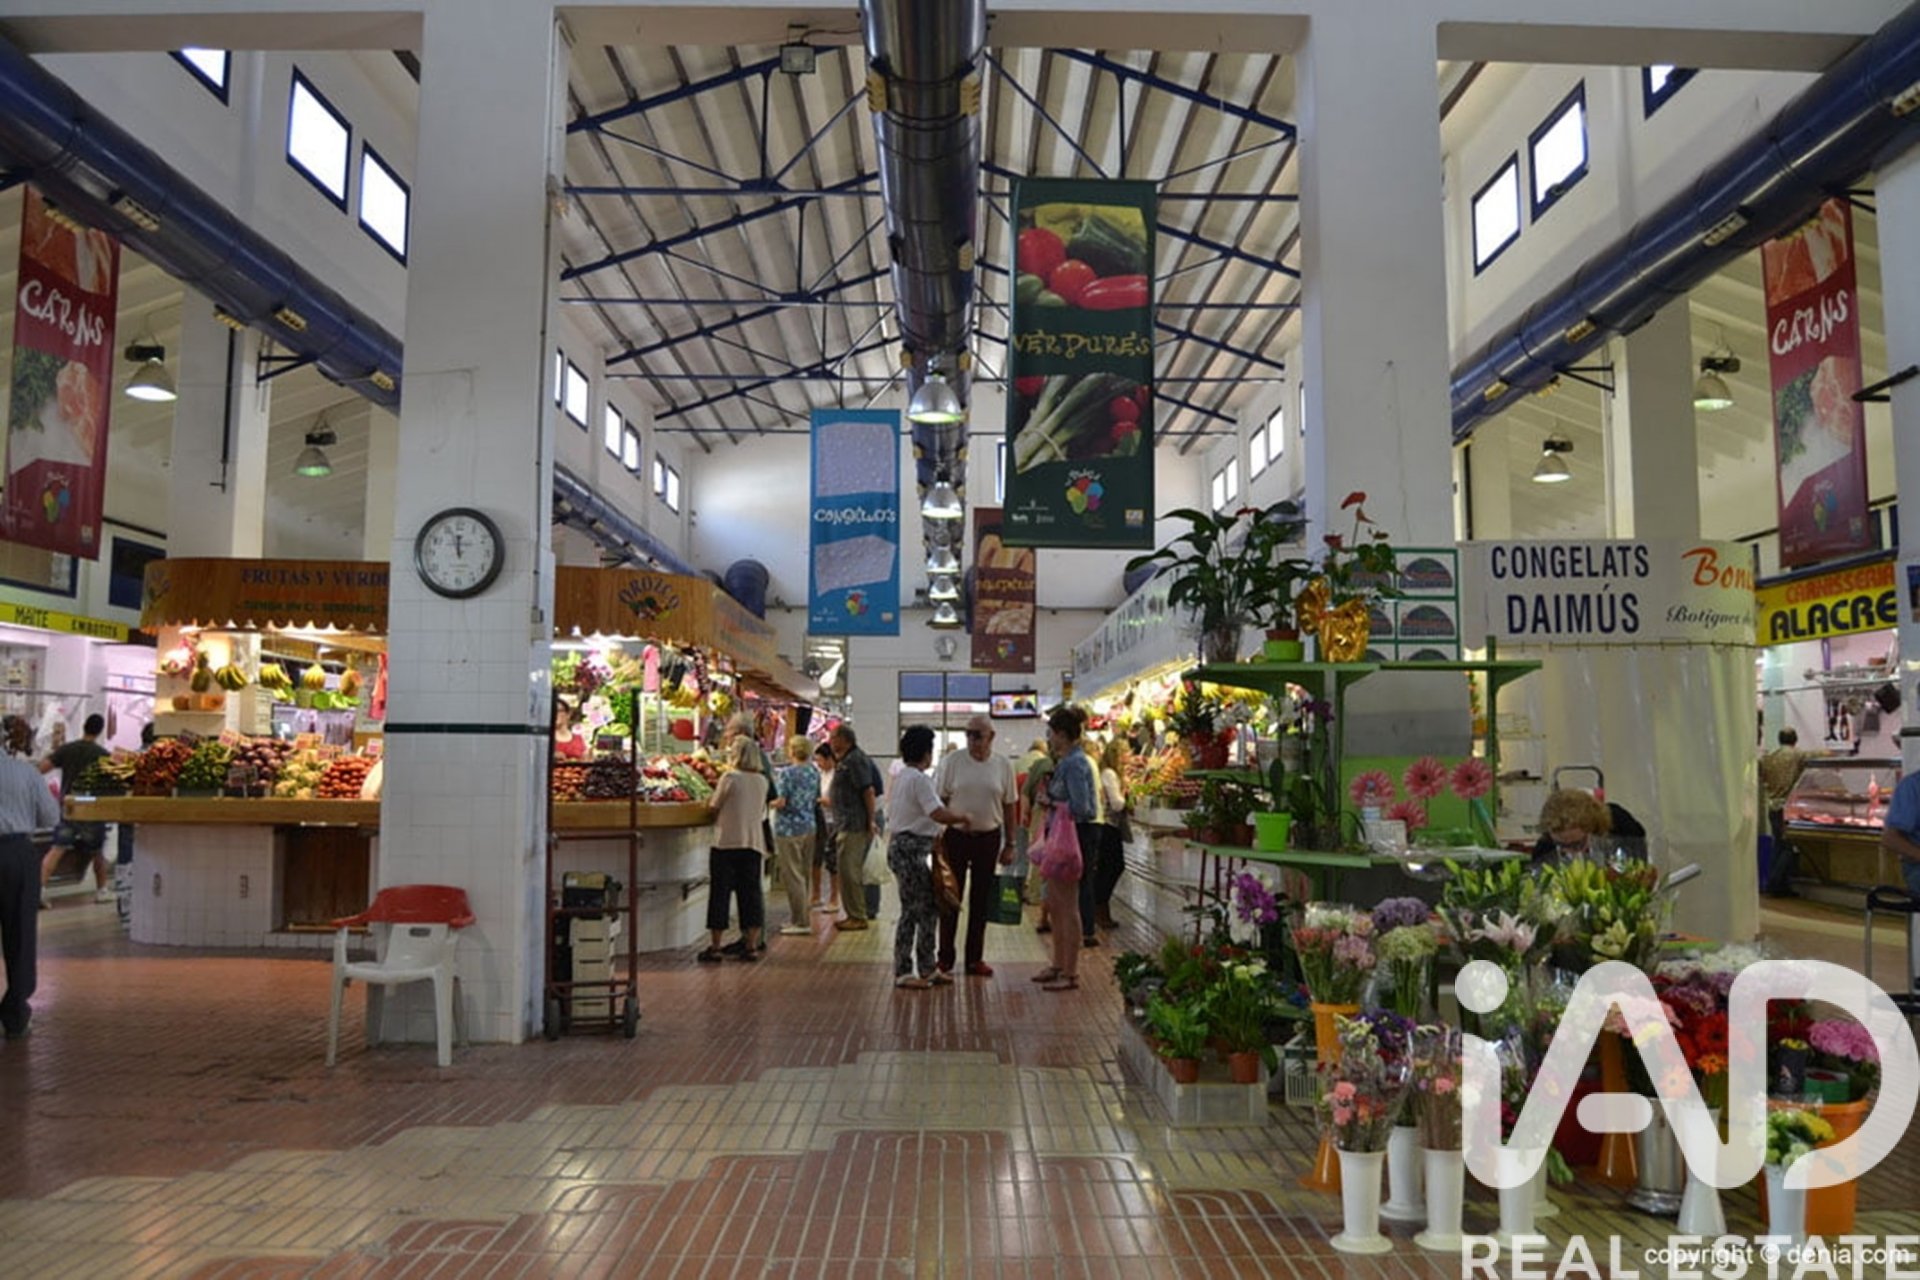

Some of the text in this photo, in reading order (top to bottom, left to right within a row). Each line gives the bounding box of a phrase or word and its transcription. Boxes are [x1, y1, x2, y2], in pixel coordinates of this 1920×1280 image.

[20, 278, 104, 346] CARNS
[1772, 289, 1848, 355] CARNS
[1013, 329, 1150, 358] VERDURES
[240, 568, 310, 585] FRUTAS
[314, 569, 327, 586] Y
[1491, 545, 1649, 580] CONGELATS
[15, 605, 49, 628] MAITE
[1508, 584, 1640, 634] DAIMÚS
[1770, 590, 1898, 641] ALACRE
